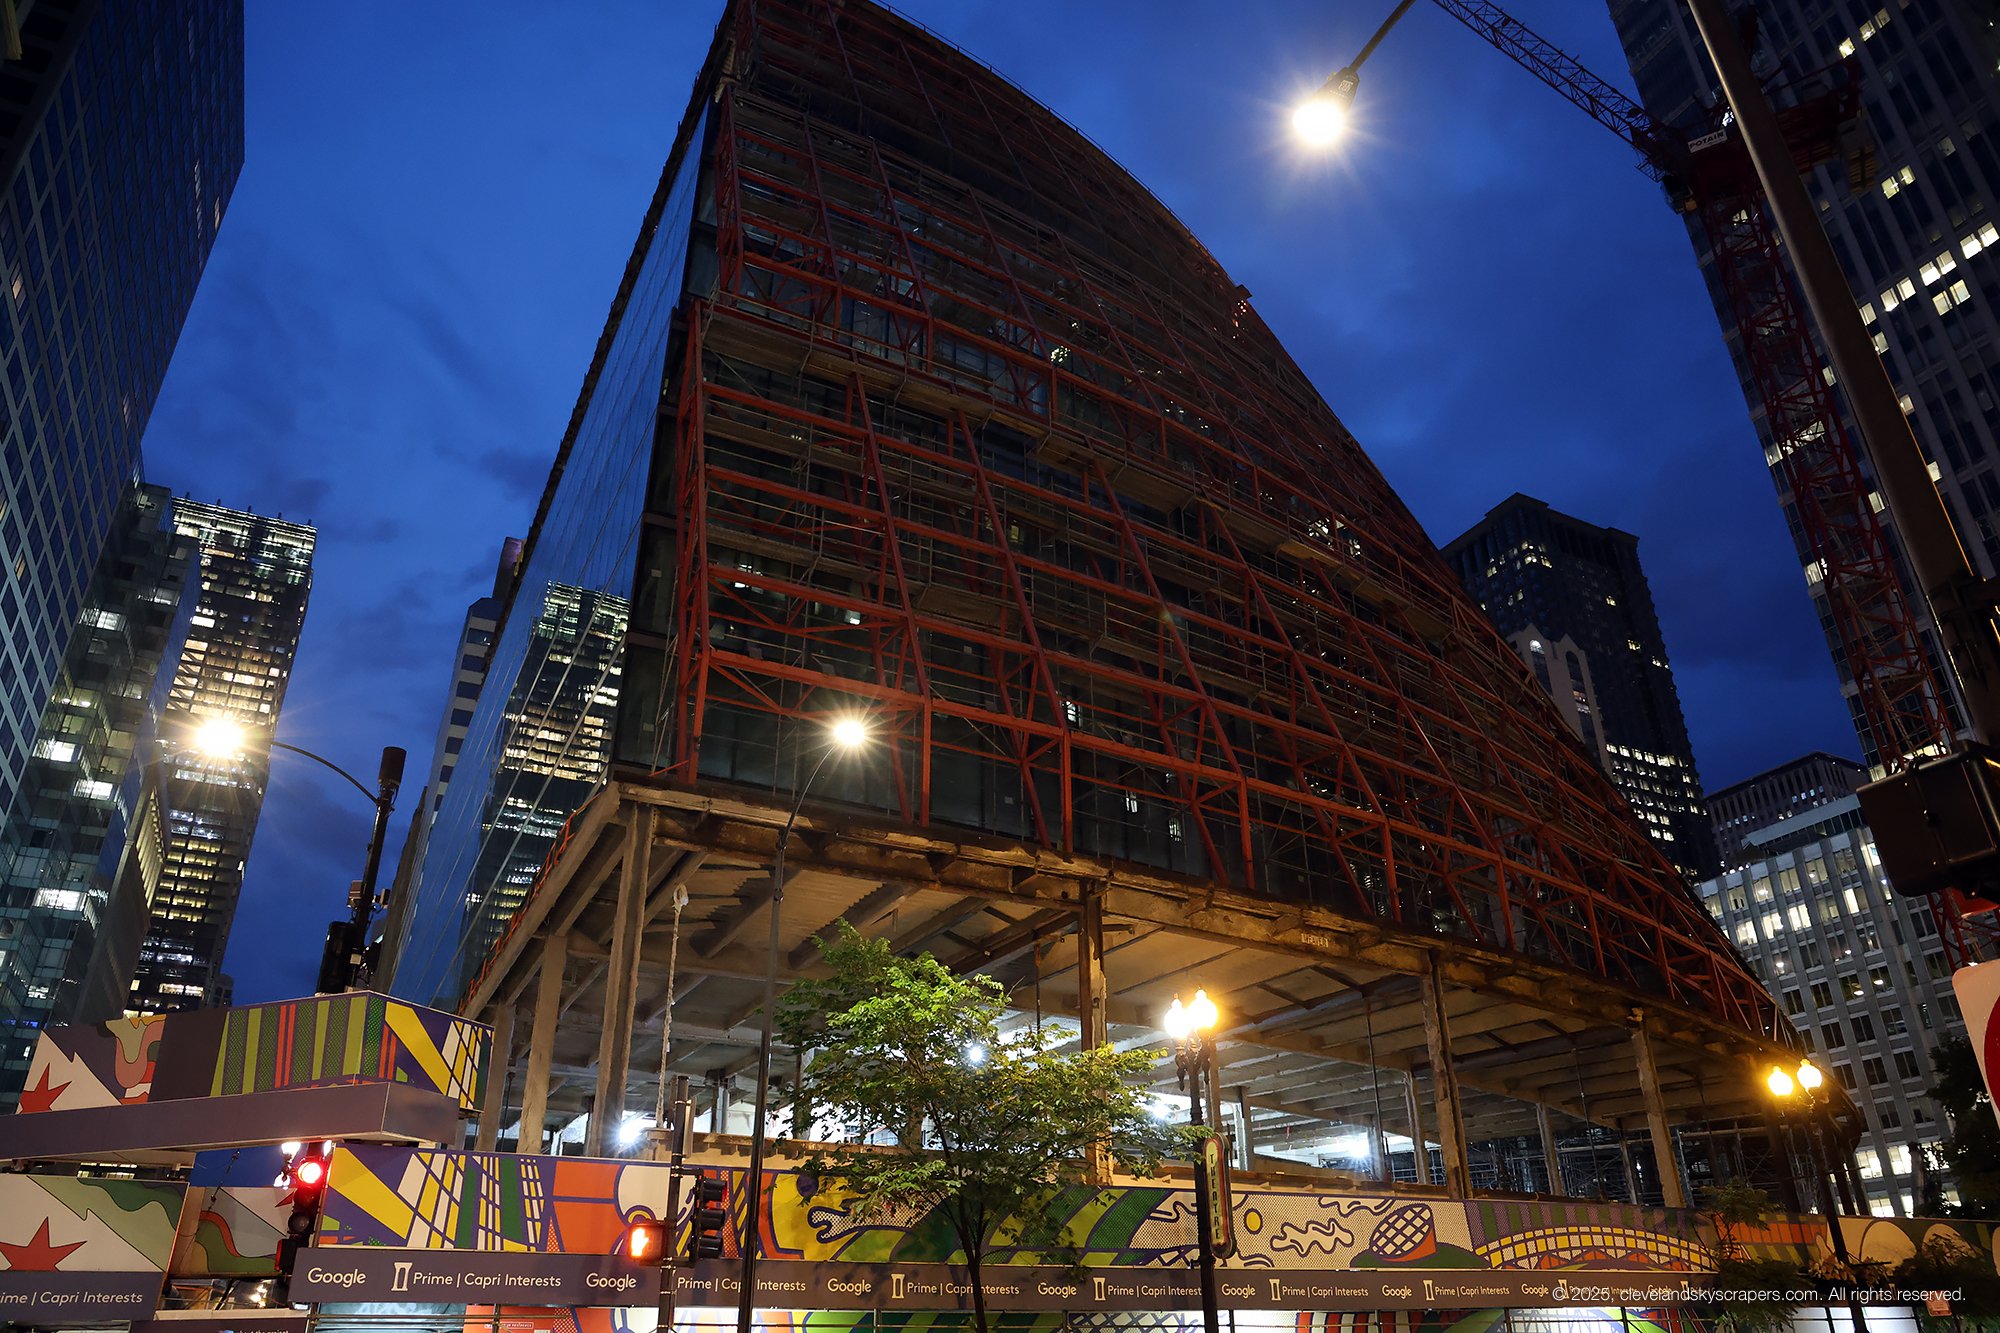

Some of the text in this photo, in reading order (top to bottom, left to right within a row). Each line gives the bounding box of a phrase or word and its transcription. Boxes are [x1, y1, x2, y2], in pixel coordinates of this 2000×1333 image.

[1689, 131, 1725, 149] POTAIN
[1209, 1153, 1220, 1240] THEATRE
[307, 1267, 367, 1288] Google
[413, 1272, 453, 1285] Prime
[464, 1273, 501, 1289] Capri
[504, 1274, 562, 1287] Interests
[586, 1272, 637, 1292] Google
[677, 1277, 712, 1290] Prime
[756, 1278, 807, 1291] Interests
[827, 1277, 872, 1297] Google
[906, 1282, 938, 1294] Prime
[945, 1283, 974, 1297] Capri
[980, 1284, 1020, 1295] nterests
[1037, 1281, 1077, 1299] Google
[1107, 1285, 1135, 1296] Prime
[1141, 1285, 1166, 1299] Capri
[1168, 1285, 1202, 1296] Interest
[1221, 1283, 1256, 1299] Google
[1282, 1286, 1306, 1296] Prime
[1311, 1286, 1333, 1298] Capri
[1335, 1287, 1369, 1297] Interests
[1381, 1284, 1413, 1300] Google
[1434, 1286, 1456, 1296] Prime
[1460, 1286, 1480, 1298] Capri
[1480, 1286, 1510, 1295] Interests
[1521, 1283, 1549, 1298] Google
[0, 1292, 28, 1304] ime
[40, 1291, 80, 1307] Capri
[83, 1291, 144, 1304] Interests
